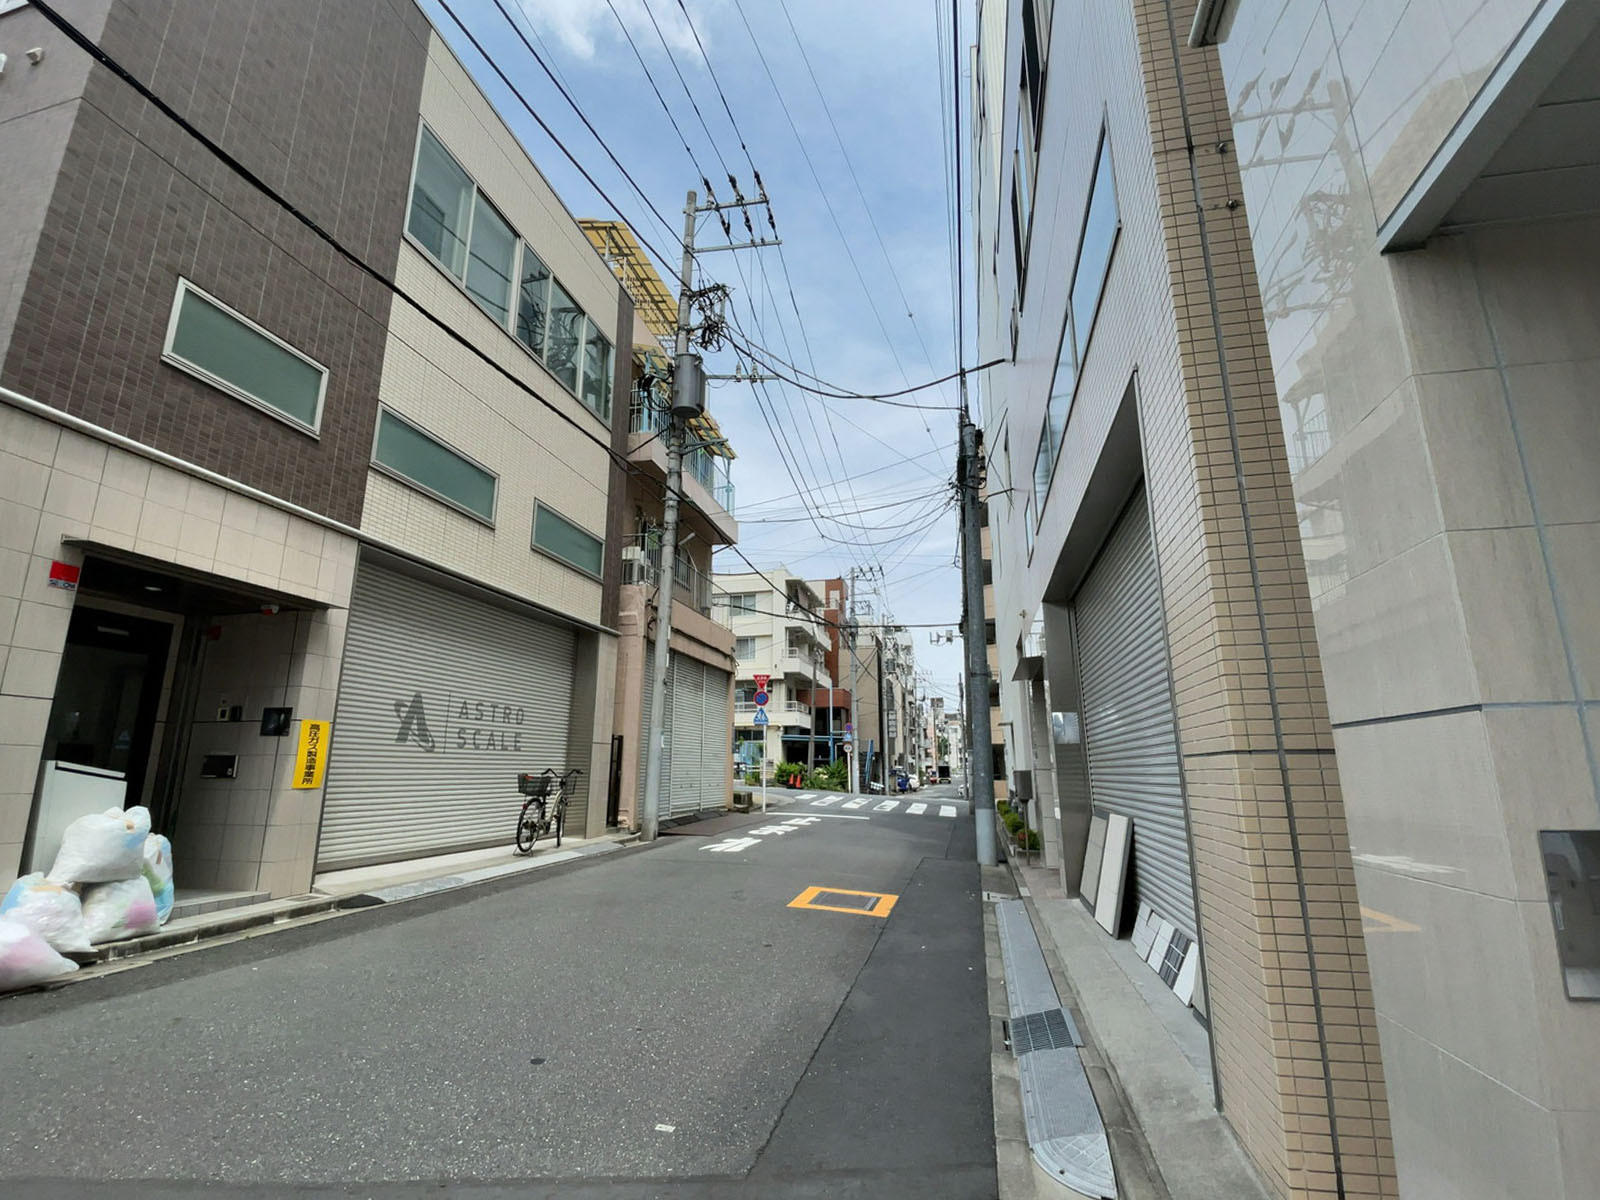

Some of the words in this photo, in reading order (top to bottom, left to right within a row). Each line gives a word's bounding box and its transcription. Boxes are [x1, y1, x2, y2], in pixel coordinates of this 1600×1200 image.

[459, 700, 525, 725] ASTRO
[301, 723, 321, 785] 高圧ガス製造事業所
[457, 728, 523, 752] SCALE
[699, 816, 822, 852] 止まれ
